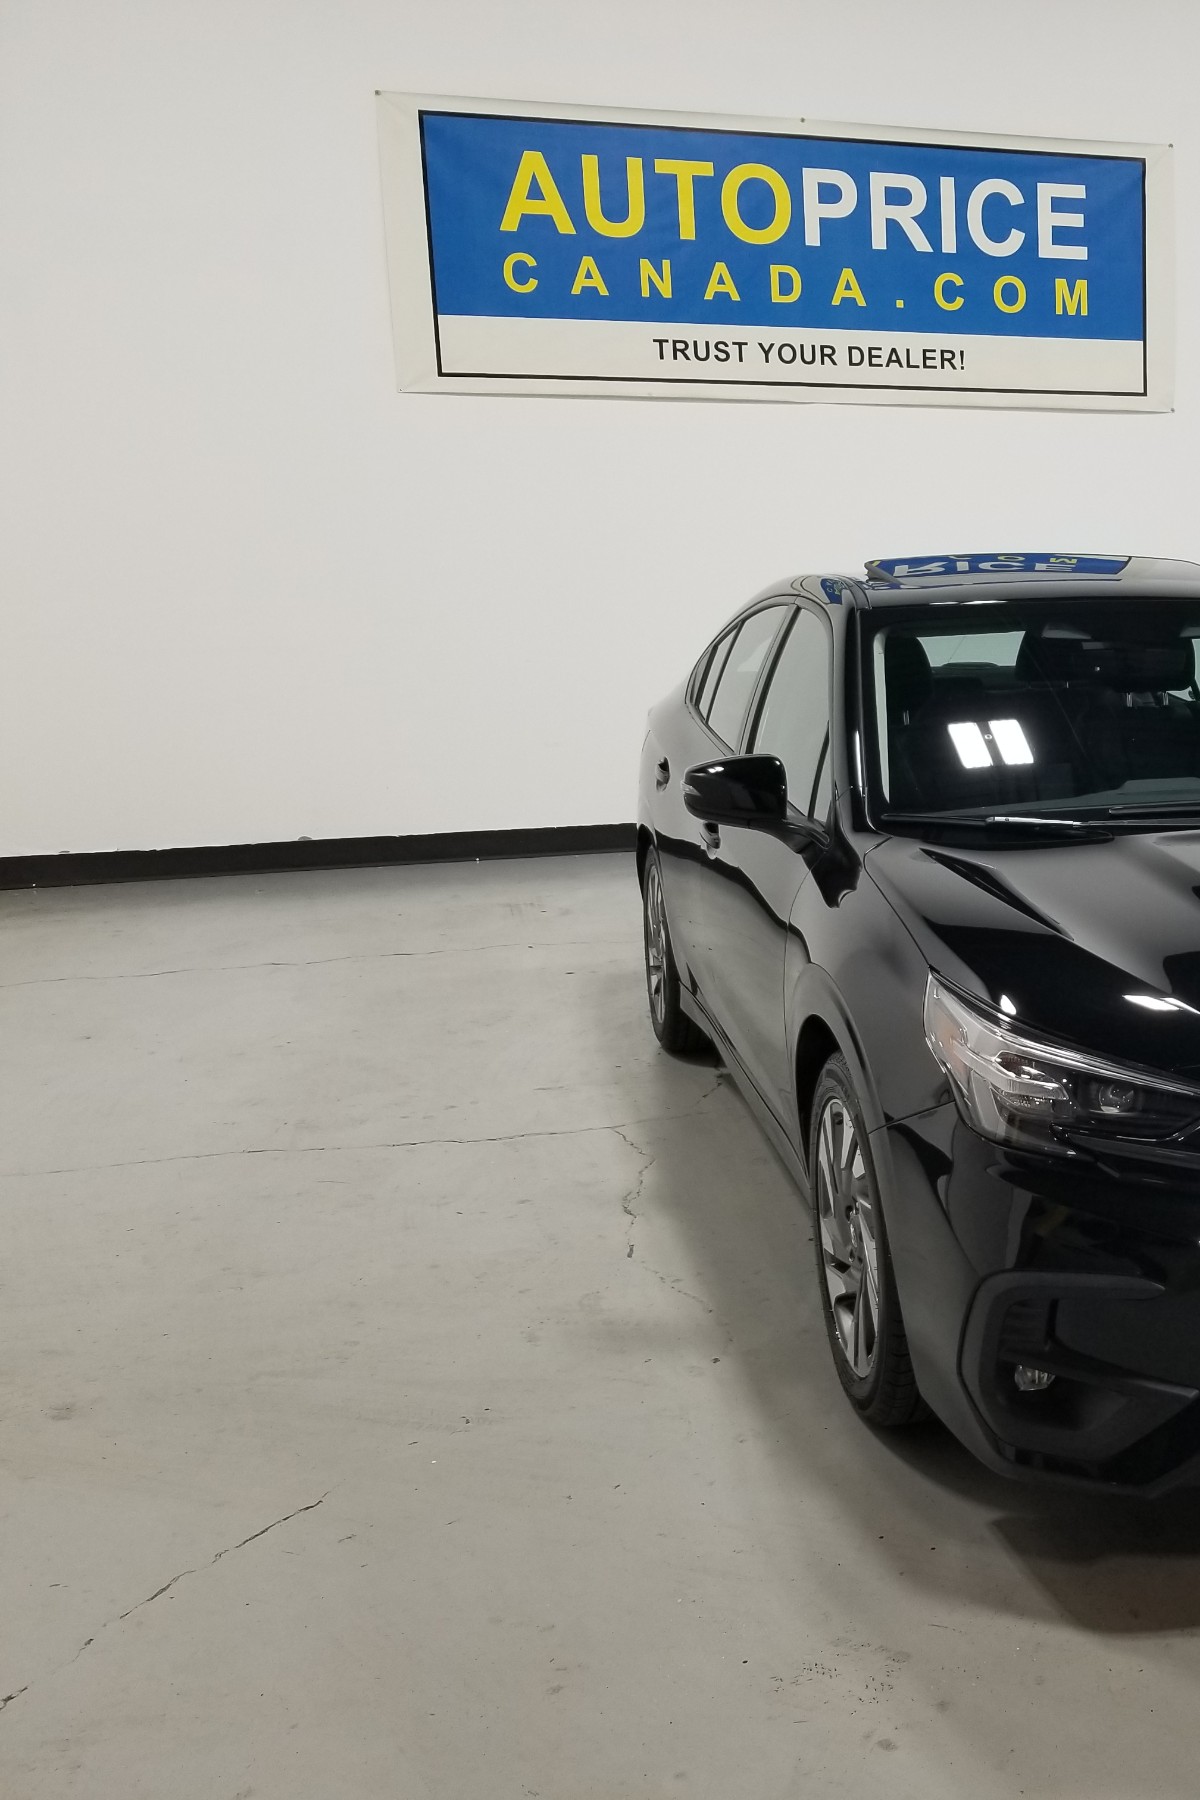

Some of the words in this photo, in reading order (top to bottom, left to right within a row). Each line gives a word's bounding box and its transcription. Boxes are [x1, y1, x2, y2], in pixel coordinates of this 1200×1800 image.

[499, 150, 1088, 260] AUTOPRICE
[502, 252, 1089, 316] CANADA.COM
[652, 338, 748, 363] TRUST
[757, 342, 837, 367] YOUR
[847, 346, 966, 371] DEALER!
